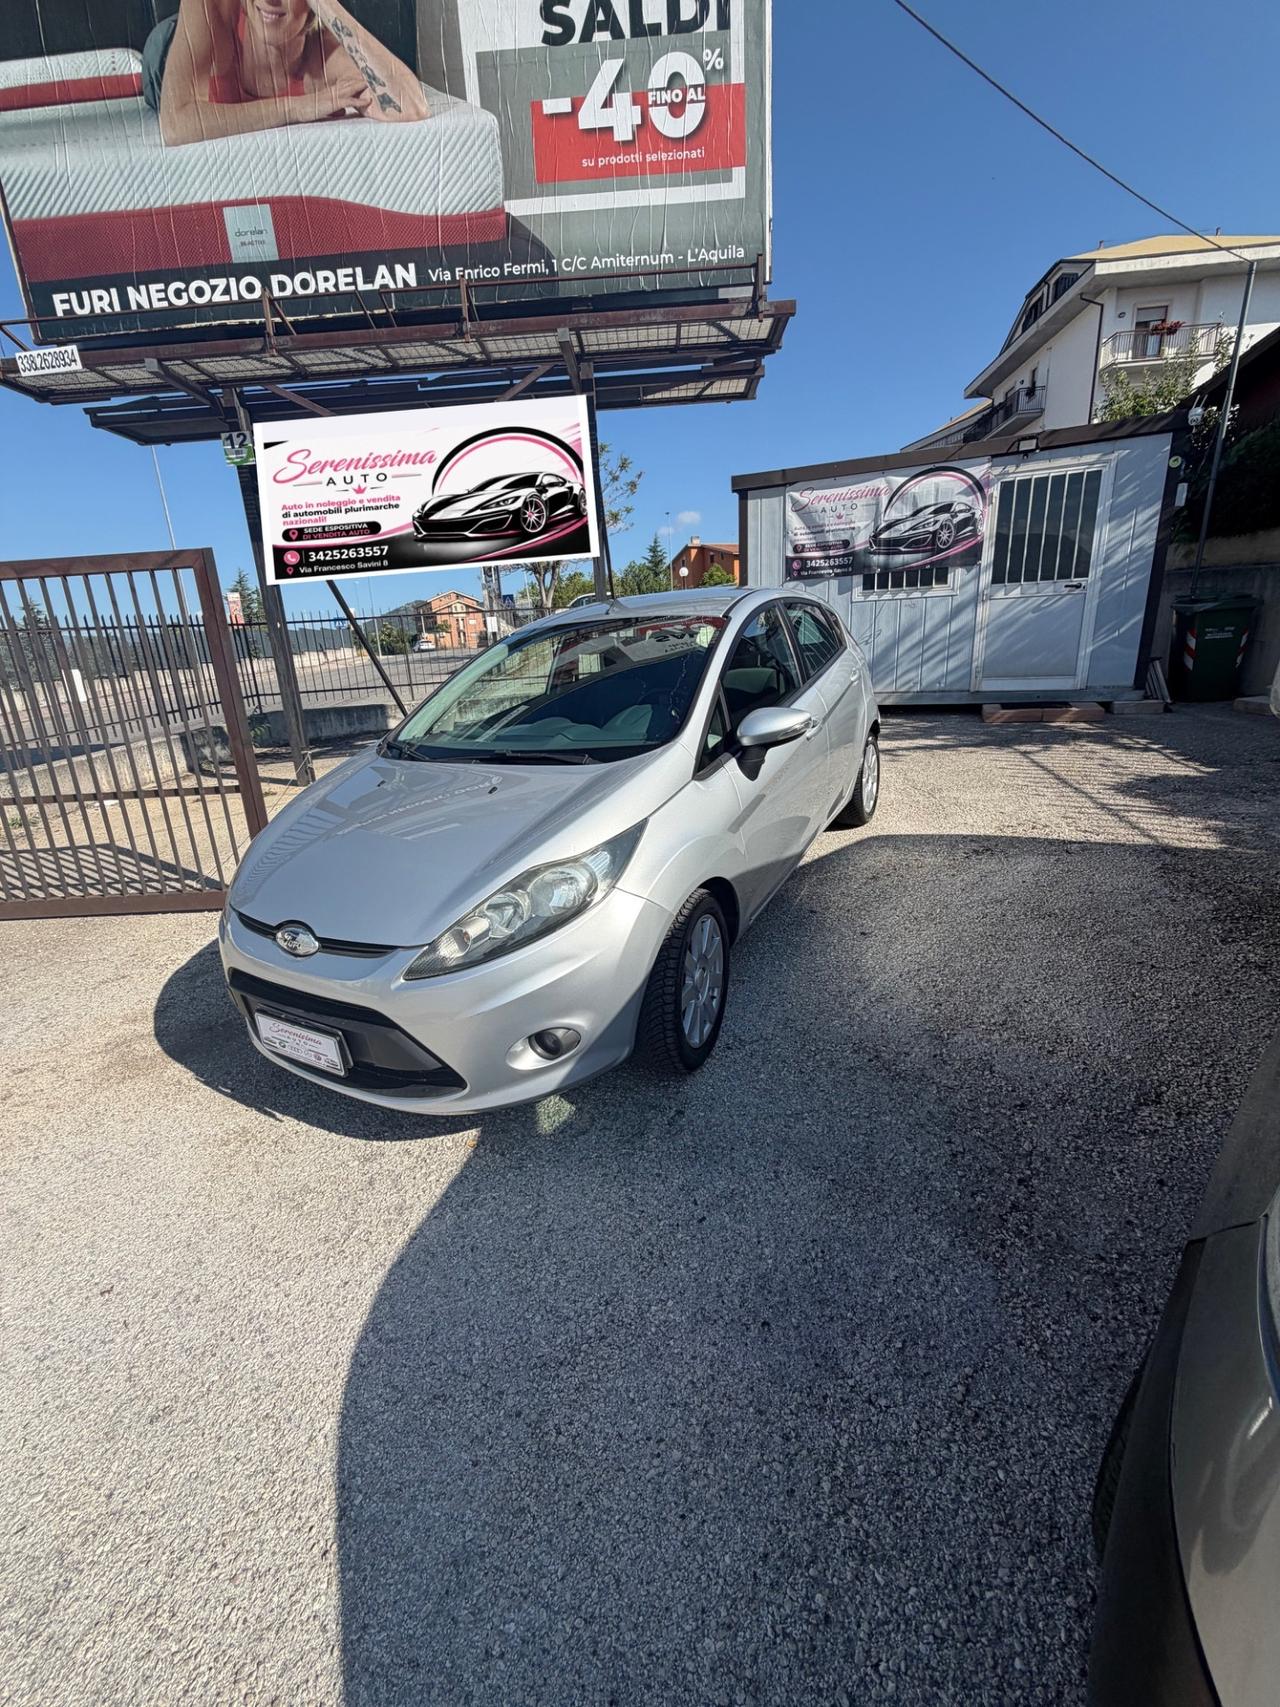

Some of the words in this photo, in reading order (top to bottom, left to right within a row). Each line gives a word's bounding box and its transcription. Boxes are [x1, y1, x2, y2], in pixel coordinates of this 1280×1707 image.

[540, 0, 731, 46] SALDI
[648, 89, 683, 105] FINO
[687, 86, 706, 101] AL
[582, 158, 595, 167] su
[598, 152, 643, 168] prodotti
[645, 147, 705, 162] selezionati
[235, 226, 268, 238] dorelan
[428, 268, 451, 282] Via
[455, 265, 500, 281] Enrico
[504, 259, 549, 276] Fermi,
[552, 259, 558, 272] 1
[561, 256, 587, 272] C/C
[591, 252, 674, 270] Amiternum
[687, 245, 745, 264] L'Aquila
[52, 288, 121, 317] FURI
[127, 276, 262, 311] NEGOZIO
[270, 263, 417, 298] DORELAN
[225, 432, 248, 449] 12
[273, 448, 437, 484] Serenissima
[326, 472, 388, 487] AUTO
[282, 503, 303, 511] Auto
[305, 501, 314, 509] in
[316, 499, 357, 508] noleggio
[366, 495, 401, 503] vendita
[791, 485, 889, 512] Serenissima
[282, 510, 291, 518] di
[293, 506, 342, 517] automobili
[344, 502, 400, 515] plurimarche
[820, 502, 858, 513] AUTO
[313, 531, 347, 540] VENDITA
[349, 528, 370, 537] AUTO
[325, 523, 368, 532] ESPOSITIVA
[308, 545, 389, 562] 3425263557
[299, 566, 312, 574] Via
[314, 563, 356, 573] Francesco
[357, 560, 382, 569] Savini
[806, 556, 854, 568] 3425263557
